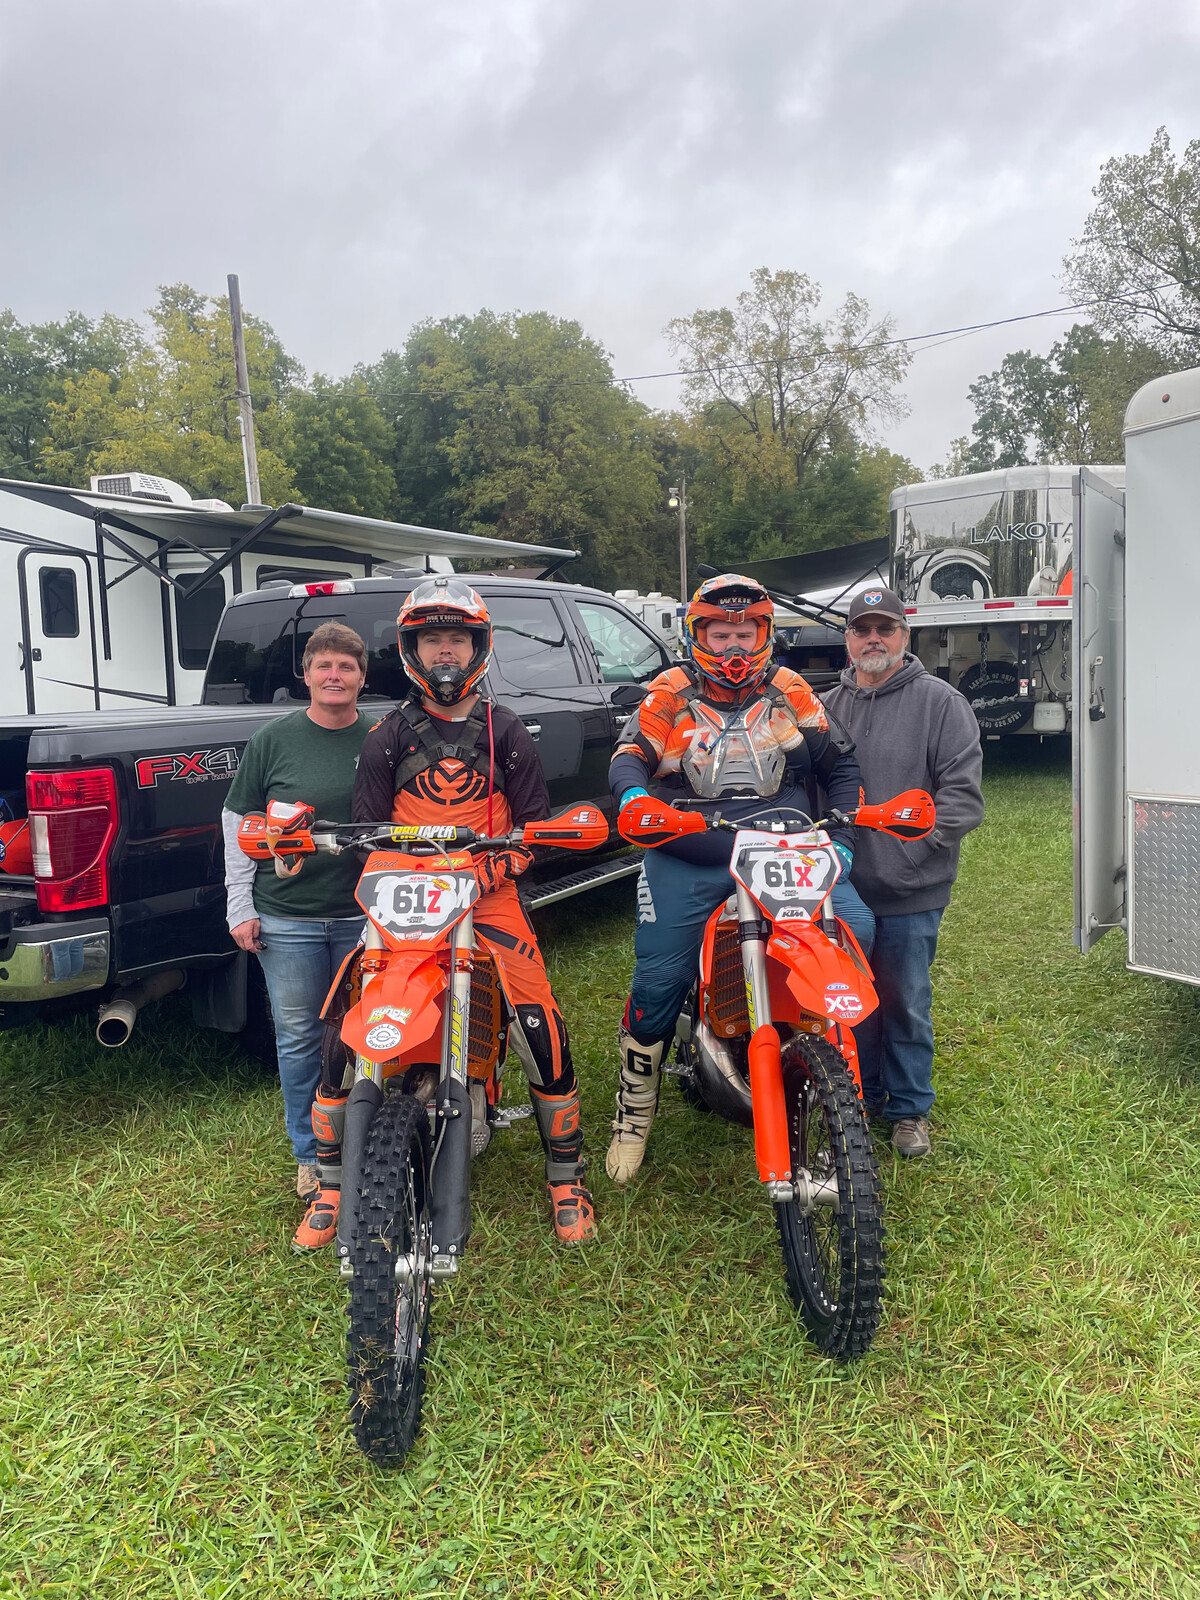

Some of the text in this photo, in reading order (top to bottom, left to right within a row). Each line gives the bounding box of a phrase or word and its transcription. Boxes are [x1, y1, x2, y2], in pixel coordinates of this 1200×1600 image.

[719, 597, 752, 605] WYLIE
[134, 747, 240, 790] FX4
[185, 775, 209, 785] OFF
[368, 859, 399, 869] Ford
[764, 860, 814, 888] 61X
[392, 884, 441, 914] 61Z
[781, 909, 804, 918] KTM
[824, 996, 863, 1014] XC
[369, 1024, 400, 1036] BULLET
[367, 1039, 396, 1049] PROOF
